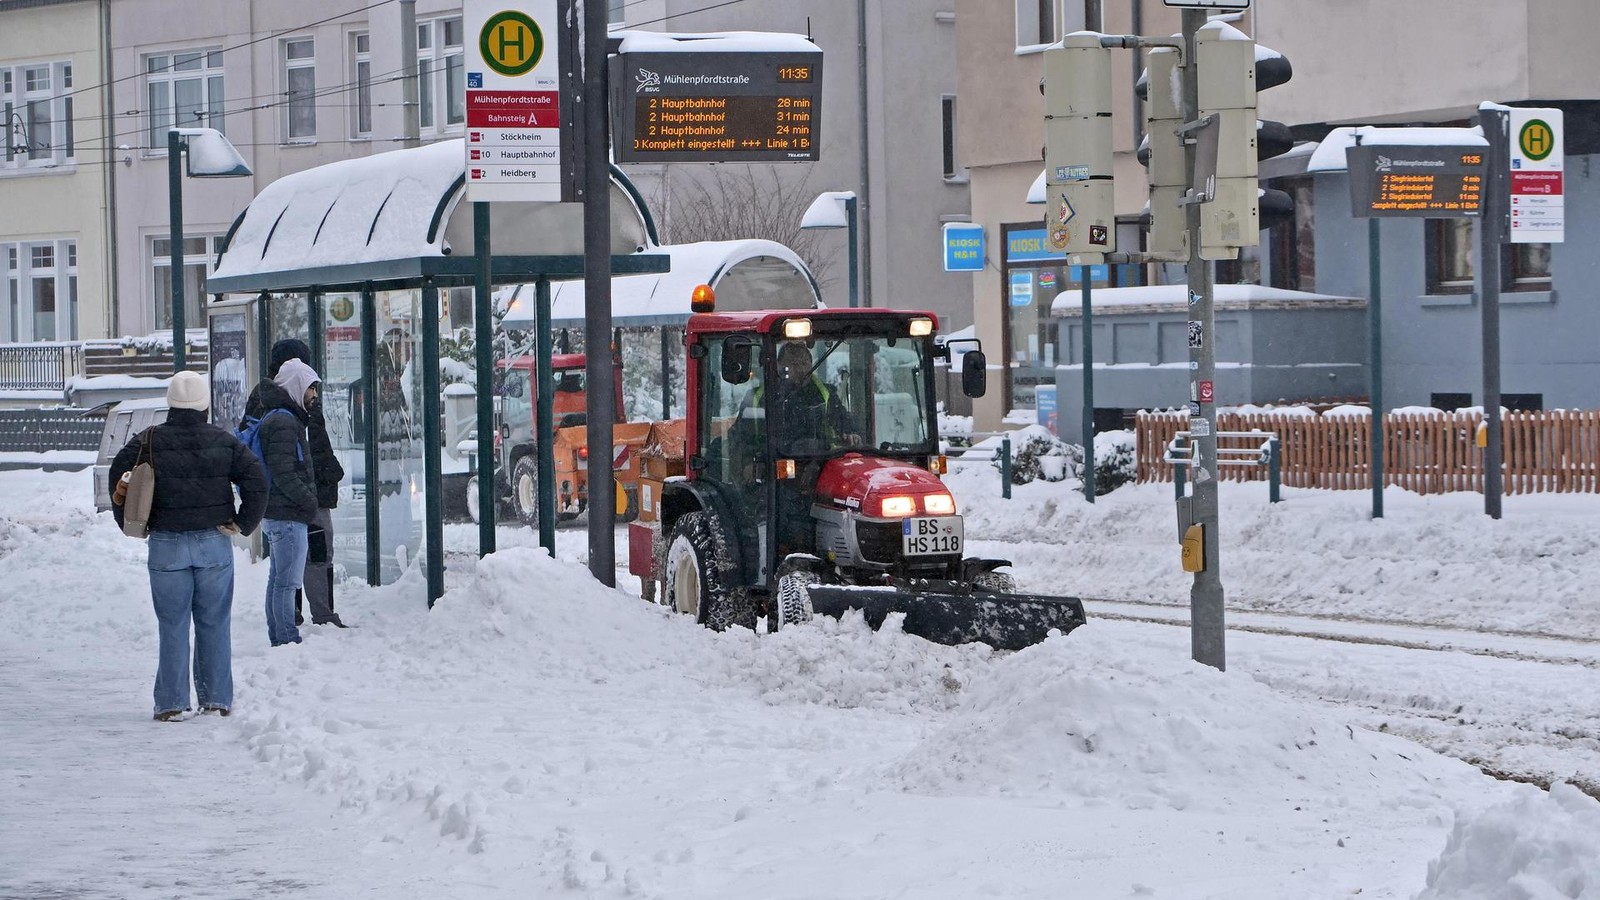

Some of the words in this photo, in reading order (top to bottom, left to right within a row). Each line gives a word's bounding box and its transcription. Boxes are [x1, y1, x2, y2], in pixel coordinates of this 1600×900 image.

[498, 26, 524, 60] H
[779, 68, 808, 79] 11:35
[664, 75, 750, 85] Mühlenpfordtstraße
[474, 96, 550, 104] Mühlenpfordtstraße
[650, 99, 657, 108] 2
[661, 98, 726, 110] Hauptbahnhof
[777, 99, 790, 108] 28
[794, 99, 810, 108] min
[488, 114, 526, 123] Bahnsteig
[528, 112, 538, 125] A
[649, 113, 656, 122] 2
[661, 112, 725, 123] Hauptbahnhof
[777, 112, 790, 121] 31
[793, 112, 810, 121] min
[649, 126, 656, 136] 2
[661, 126, 725, 137] Hauptbahnhof
[776, 126, 790, 134] 24
[792, 126, 809, 134] min
[642, 139, 685, 150] Komplett
[688, 139, 735, 150] eingestellt
[767, 139, 788, 148] Linie
[792, 139, 797, 147] 1
[801, 139, 809, 147] B
[1529, 128, 1544, 152] H
[500, 151, 556, 159] Hauptbahnhof
[1462, 155, 1480, 164] 11:35
[500, 170, 536, 178] Heidberg
[1545, 185, 1551, 193] B
[949, 239, 980, 248] KIOSK
[1010, 238, 1040, 252] KIOSK
[918, 520, 938, 535] BS
[908, 537, 928, 553] HS
[931, 536, 959, 552] 118
